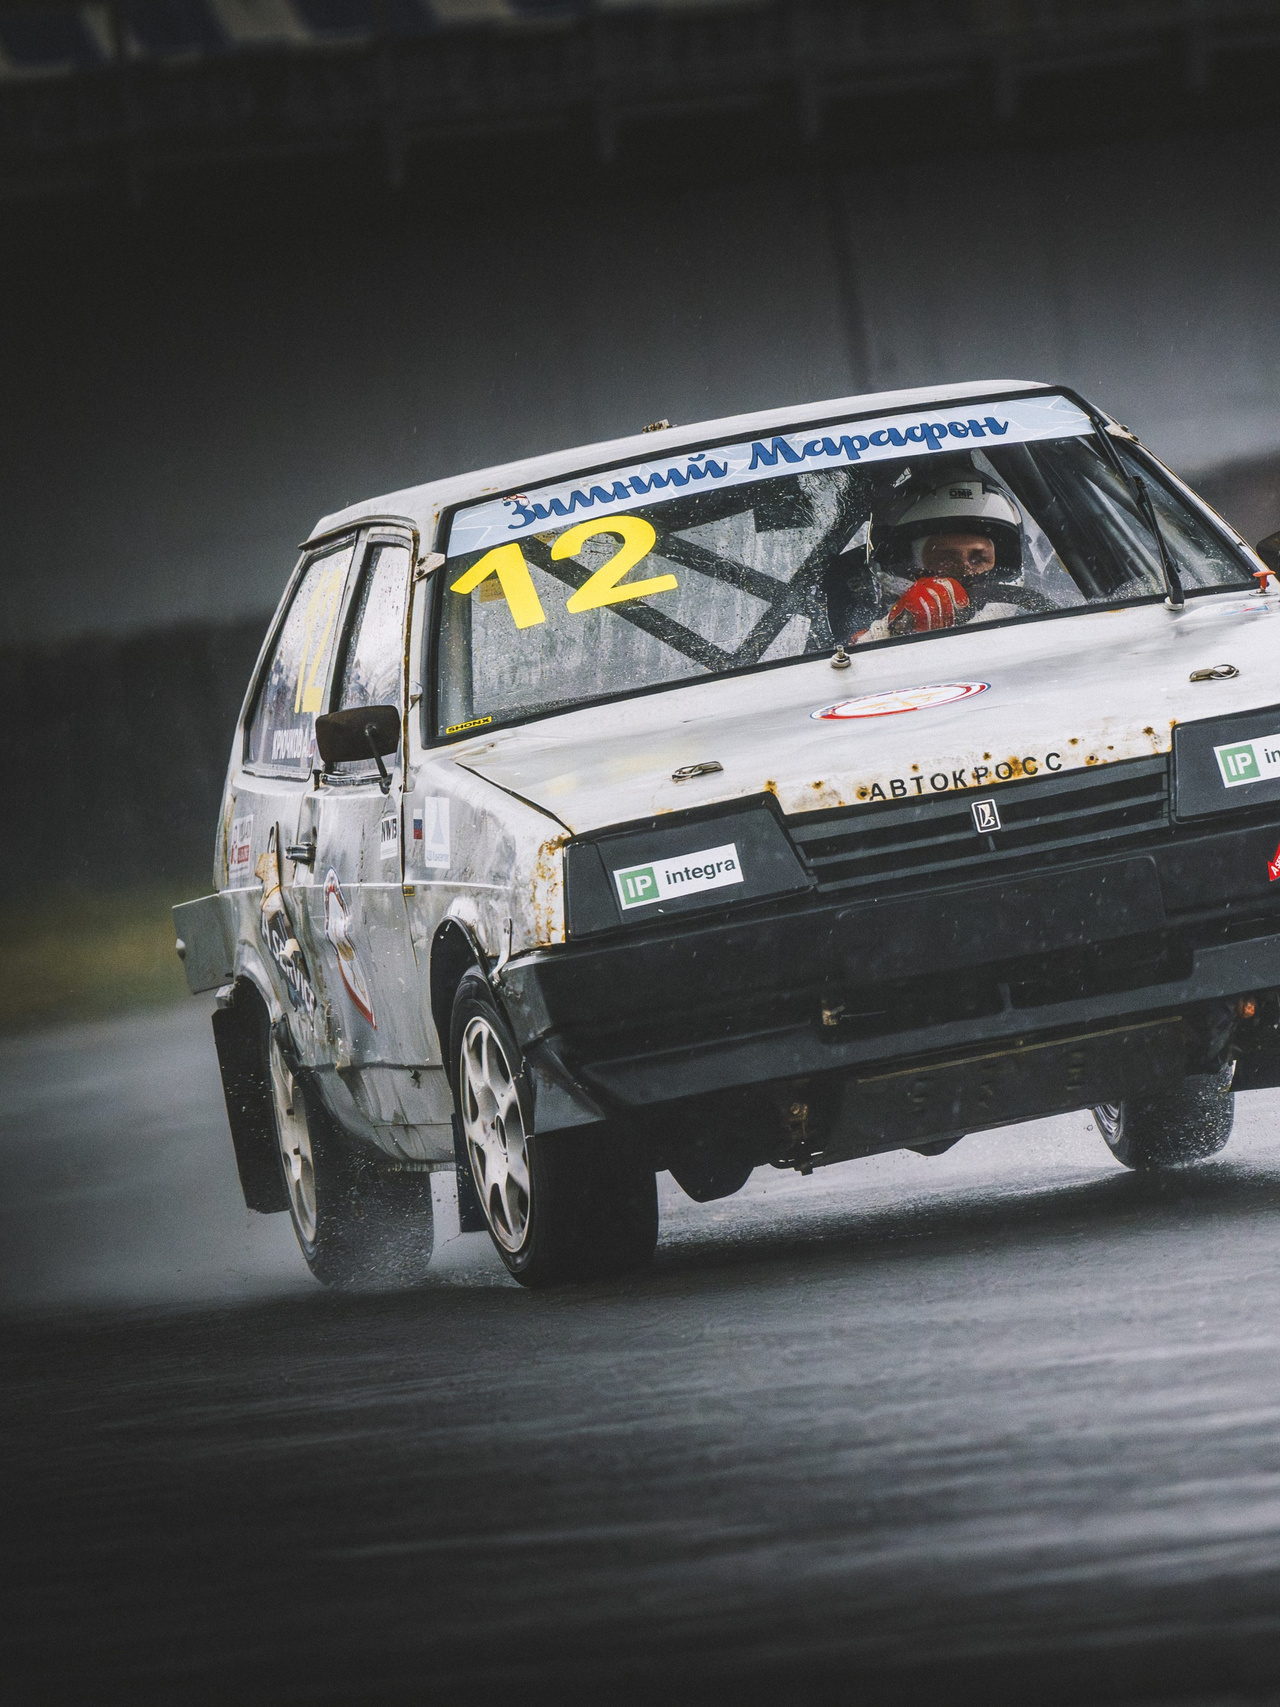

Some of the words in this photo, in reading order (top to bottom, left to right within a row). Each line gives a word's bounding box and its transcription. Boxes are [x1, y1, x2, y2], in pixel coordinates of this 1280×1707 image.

[502, 453, 729, 530] Зимний
[748, 416, 1009, 470] Марафон
[449, 515, 679, 630] 12
[869, 752, 1063, 801] АВТОКРОСС
[1226, 752, 1252, 776] IP
[625, 875, 652, 898] IP
[665, 859, 736, 884] integra
[1270, 865, 1280, 876] A
